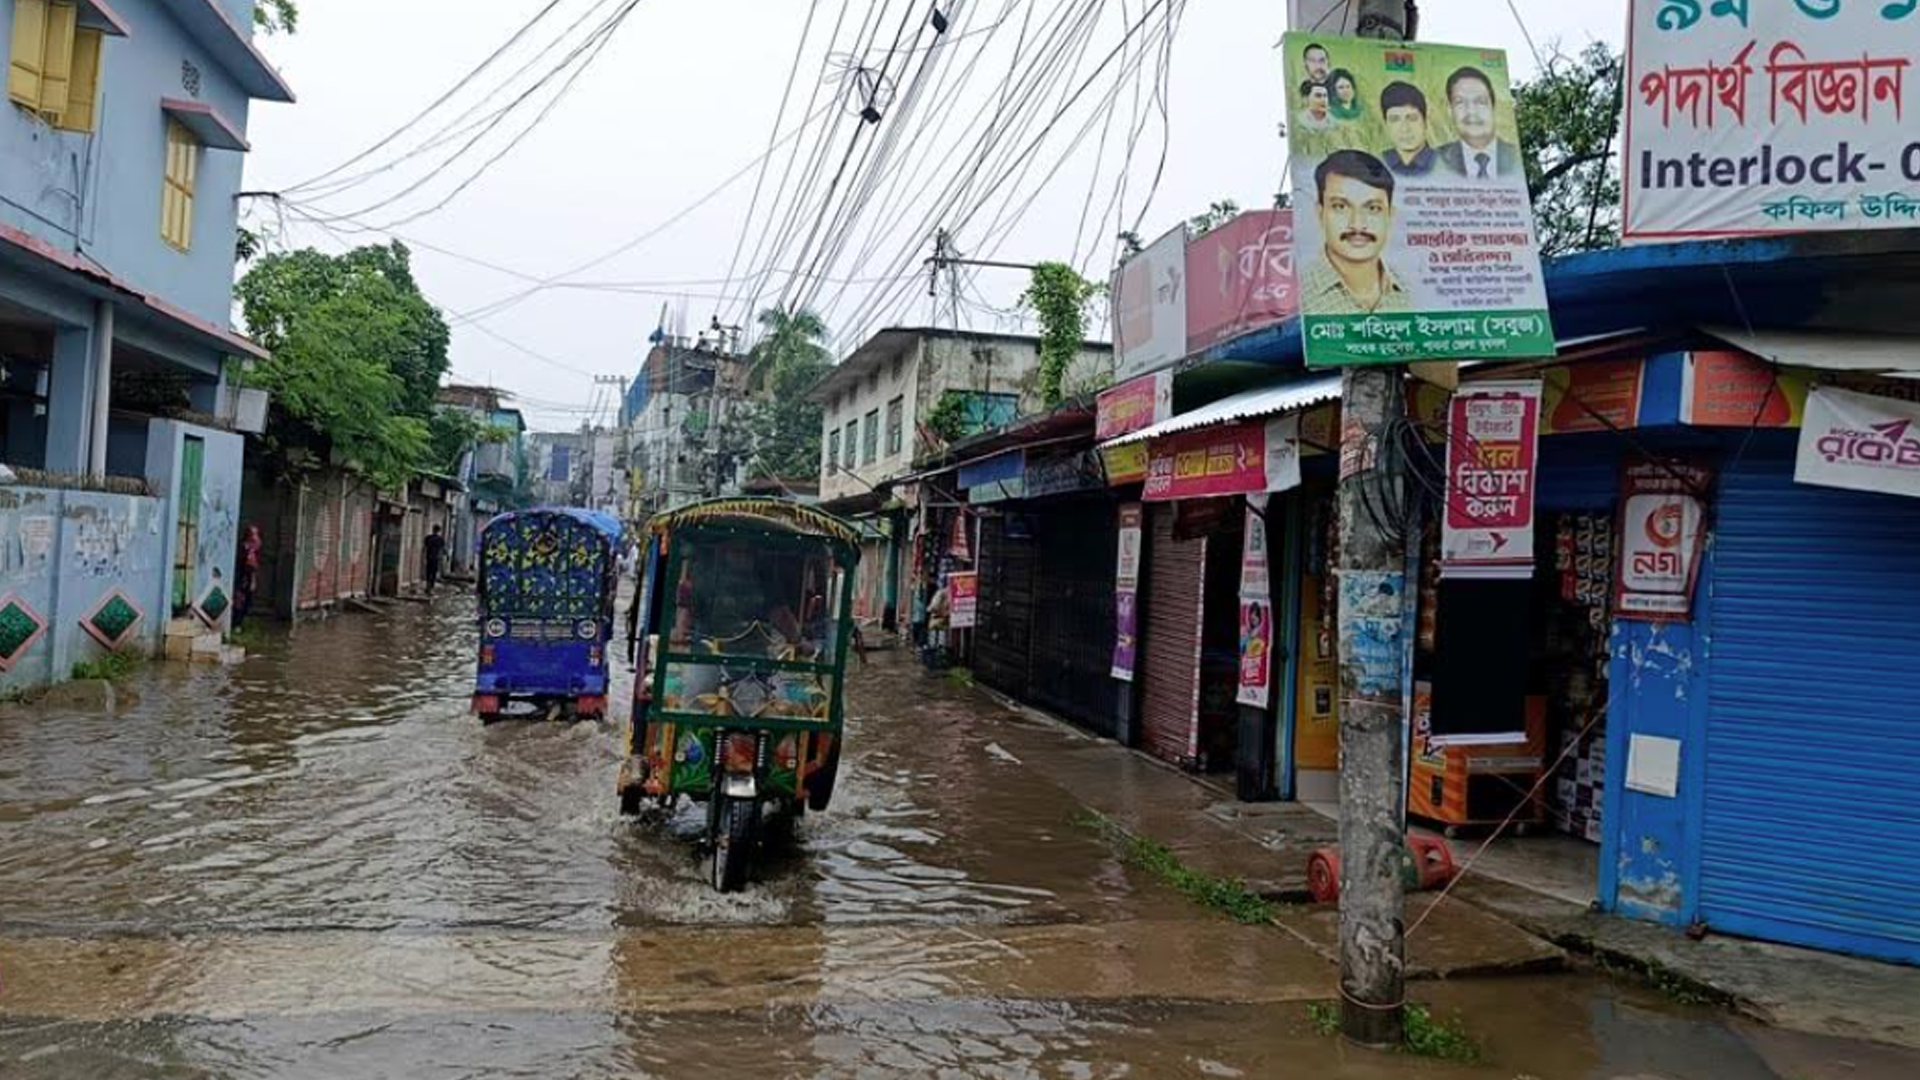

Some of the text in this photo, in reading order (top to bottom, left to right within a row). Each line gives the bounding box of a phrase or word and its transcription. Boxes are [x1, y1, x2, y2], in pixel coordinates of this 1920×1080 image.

[1640, 40, 1911, 128] পদার্থ বিজ্ঞান
[1641, 142, 1886, 188] Interlock-
[1762, 192, 1920, 221] কফিল উদ্দি
[1238, 226, 1294, 284] রবি
[1311, 313, 1544, 340] মোঃ শহিদুল ইসলাম (সবুজ)
[1457, 464, 1528, 495] বিকাশ
[1466, 496, 1517, 520] করুন
